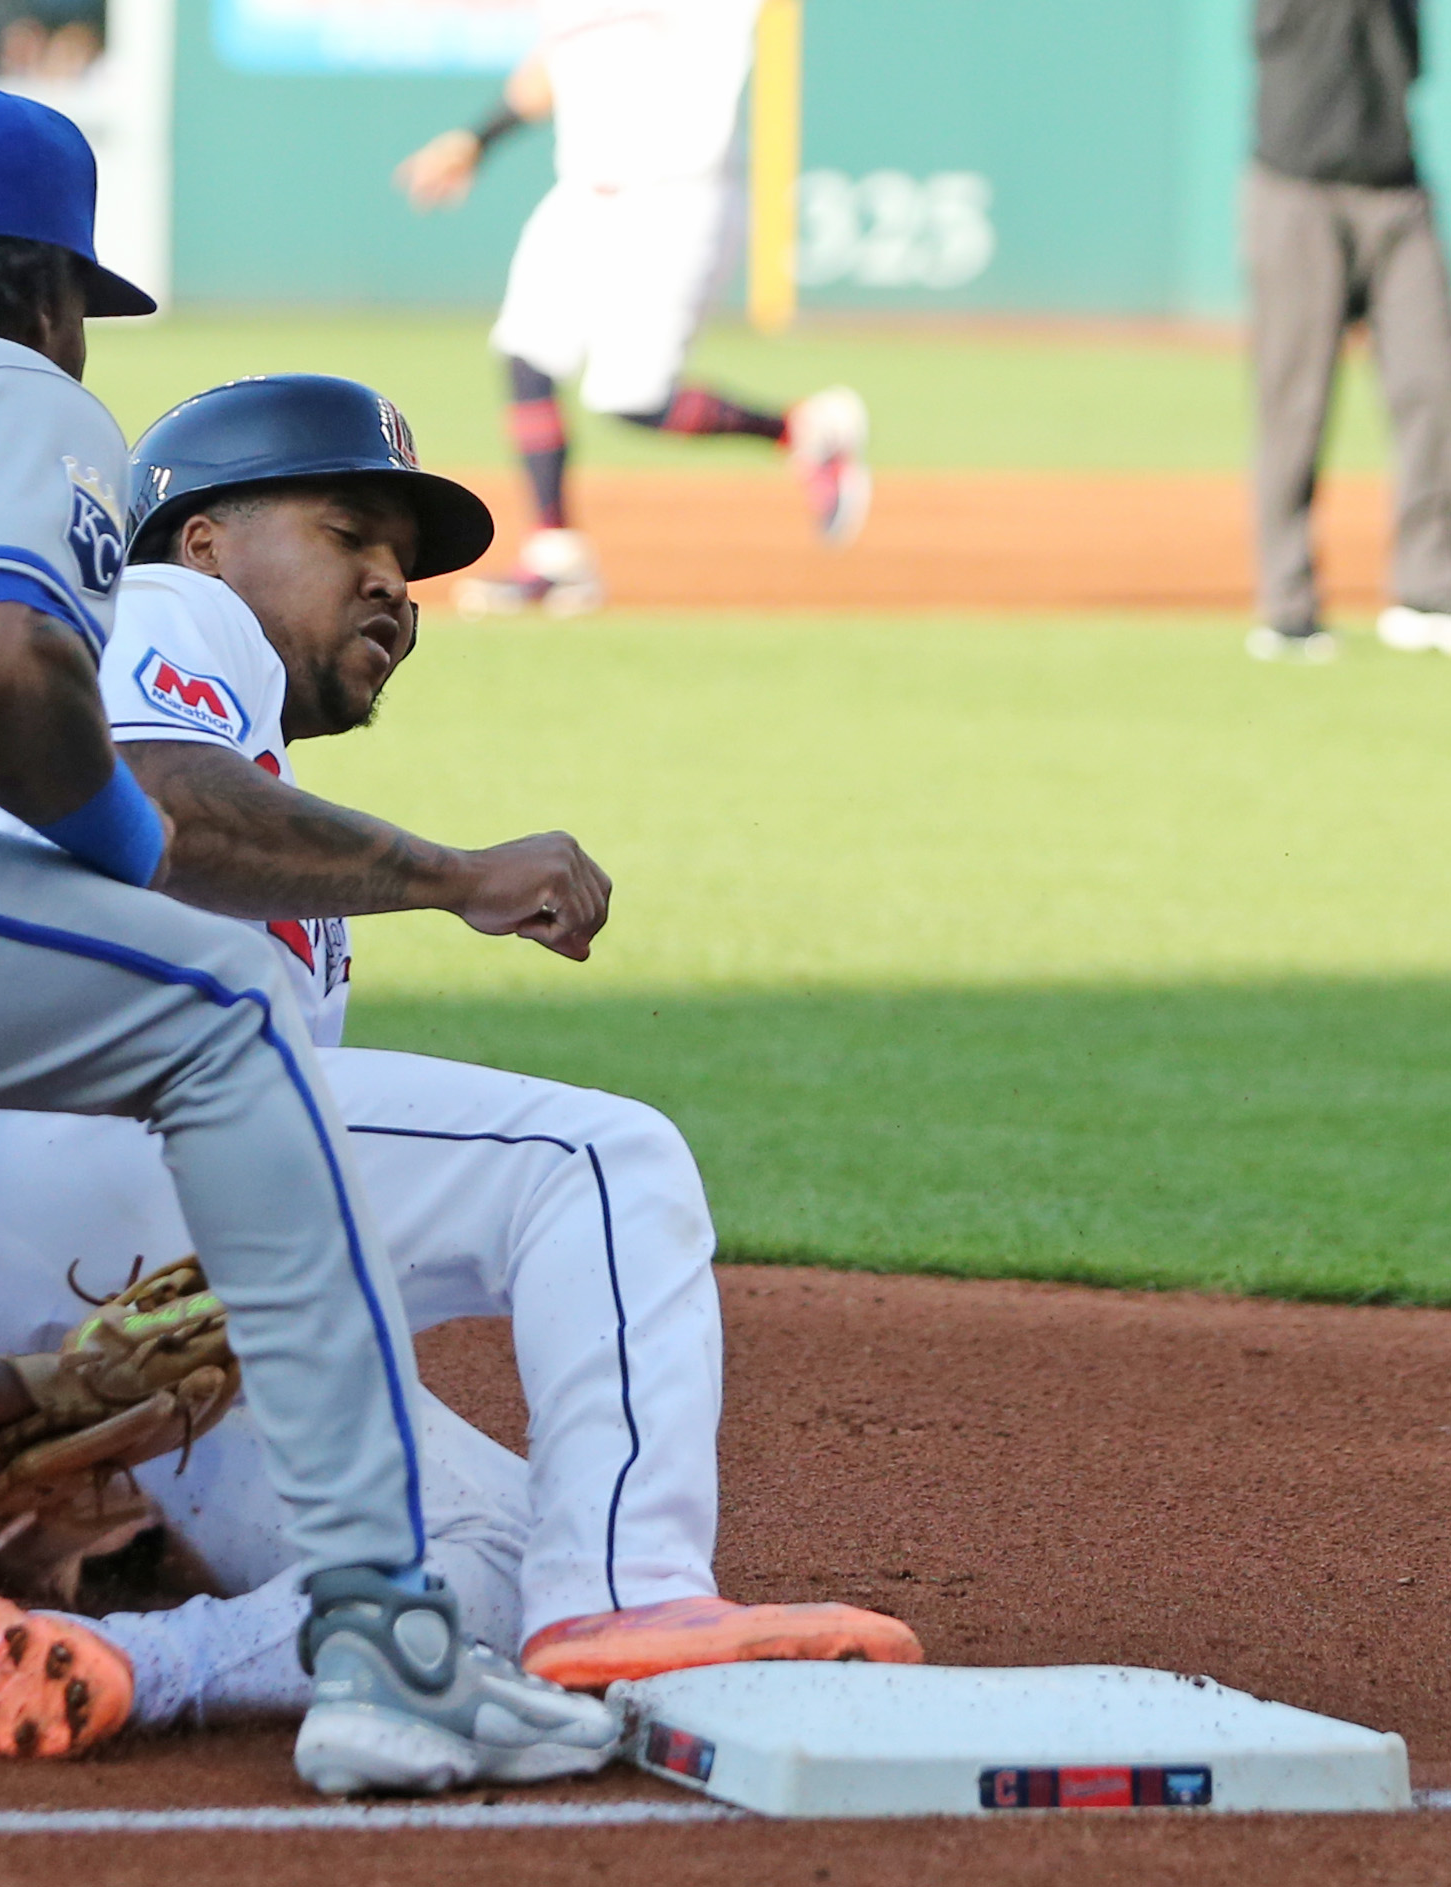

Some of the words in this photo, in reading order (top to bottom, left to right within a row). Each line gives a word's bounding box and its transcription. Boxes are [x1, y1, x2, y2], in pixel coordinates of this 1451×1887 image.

[788, 168, 996, 290] 325
[72, 490, 122, 587] KC
[151, 687, 235, 736] Marathon
